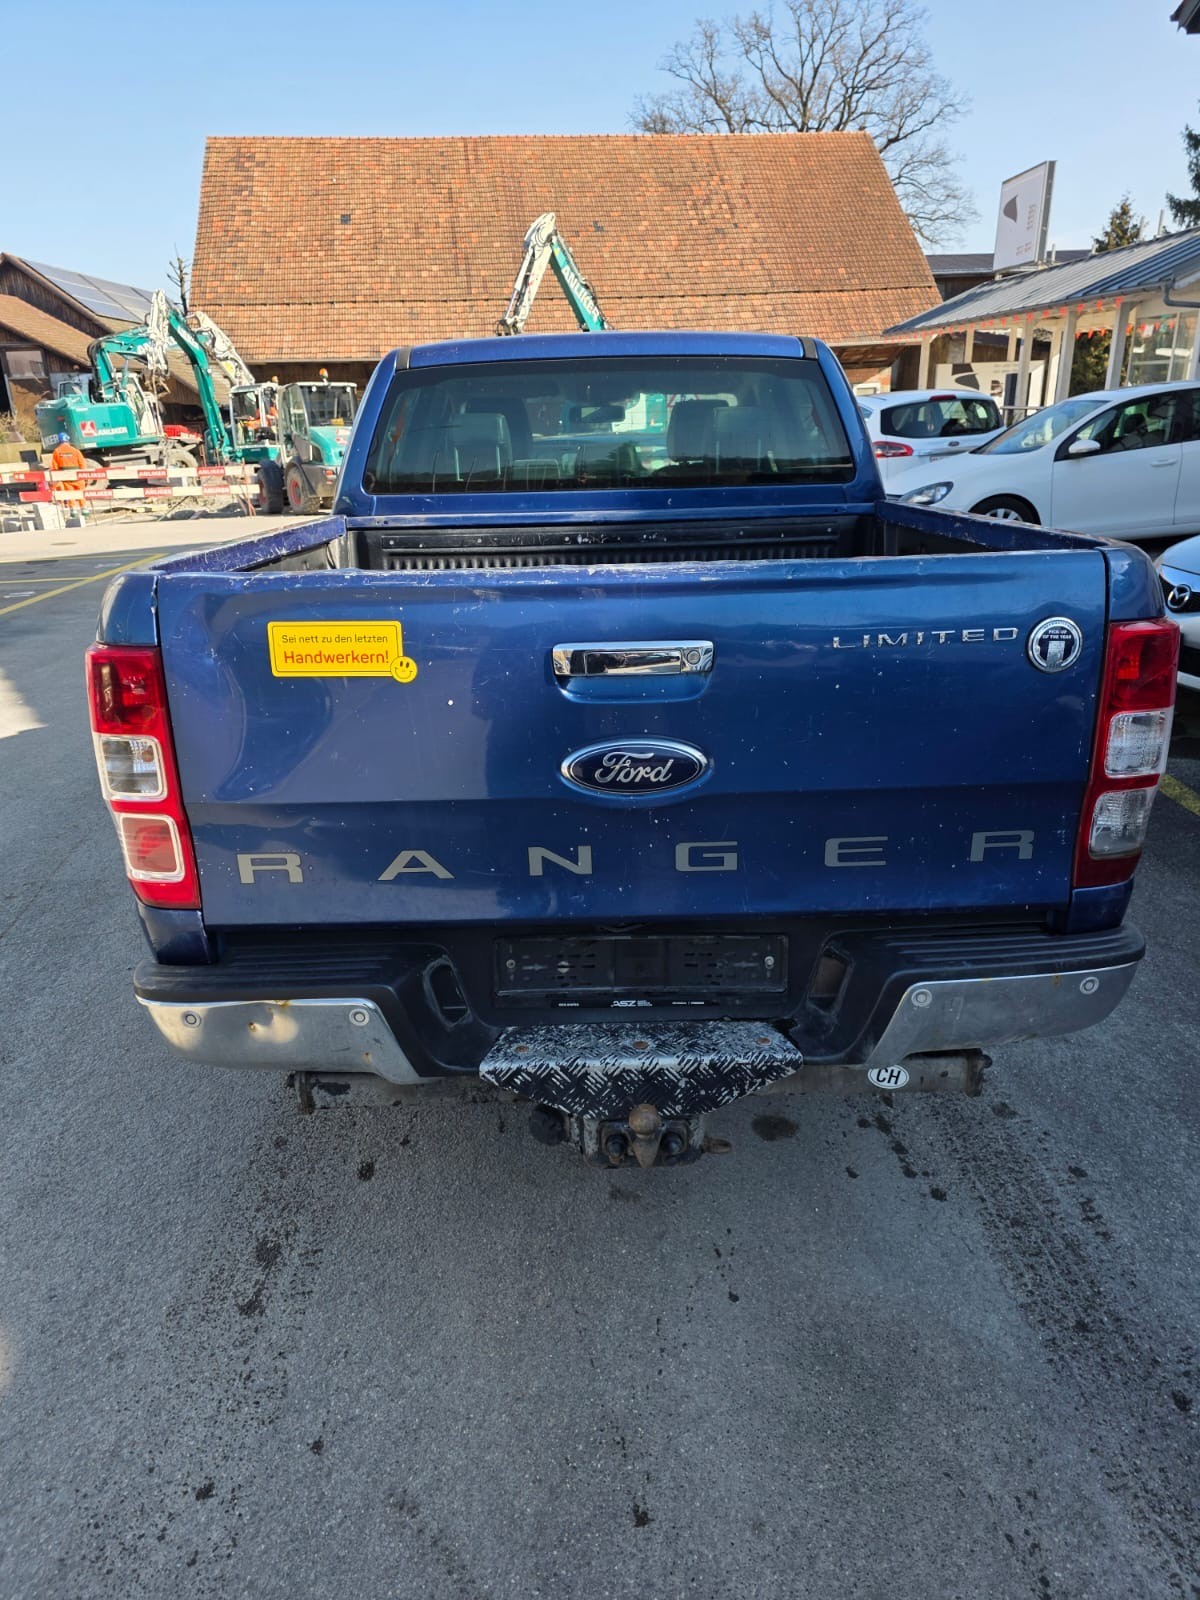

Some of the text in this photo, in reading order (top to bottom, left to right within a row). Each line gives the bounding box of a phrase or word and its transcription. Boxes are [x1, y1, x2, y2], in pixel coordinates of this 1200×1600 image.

[281, 634, 297, 644] Sei
[299, 635, 319, 643] nett
[334, 634, 352, 643] den
[354, 634, 388, 643] letzten
[832, 627, 1019, 649] LIMITED
[283, 650, 389, 664] Handwerkern!
[594, 751, 675, 784] Ford
[236, 829, 1035, 885] RANGER
[876, 1067, 901, 1085] CH
